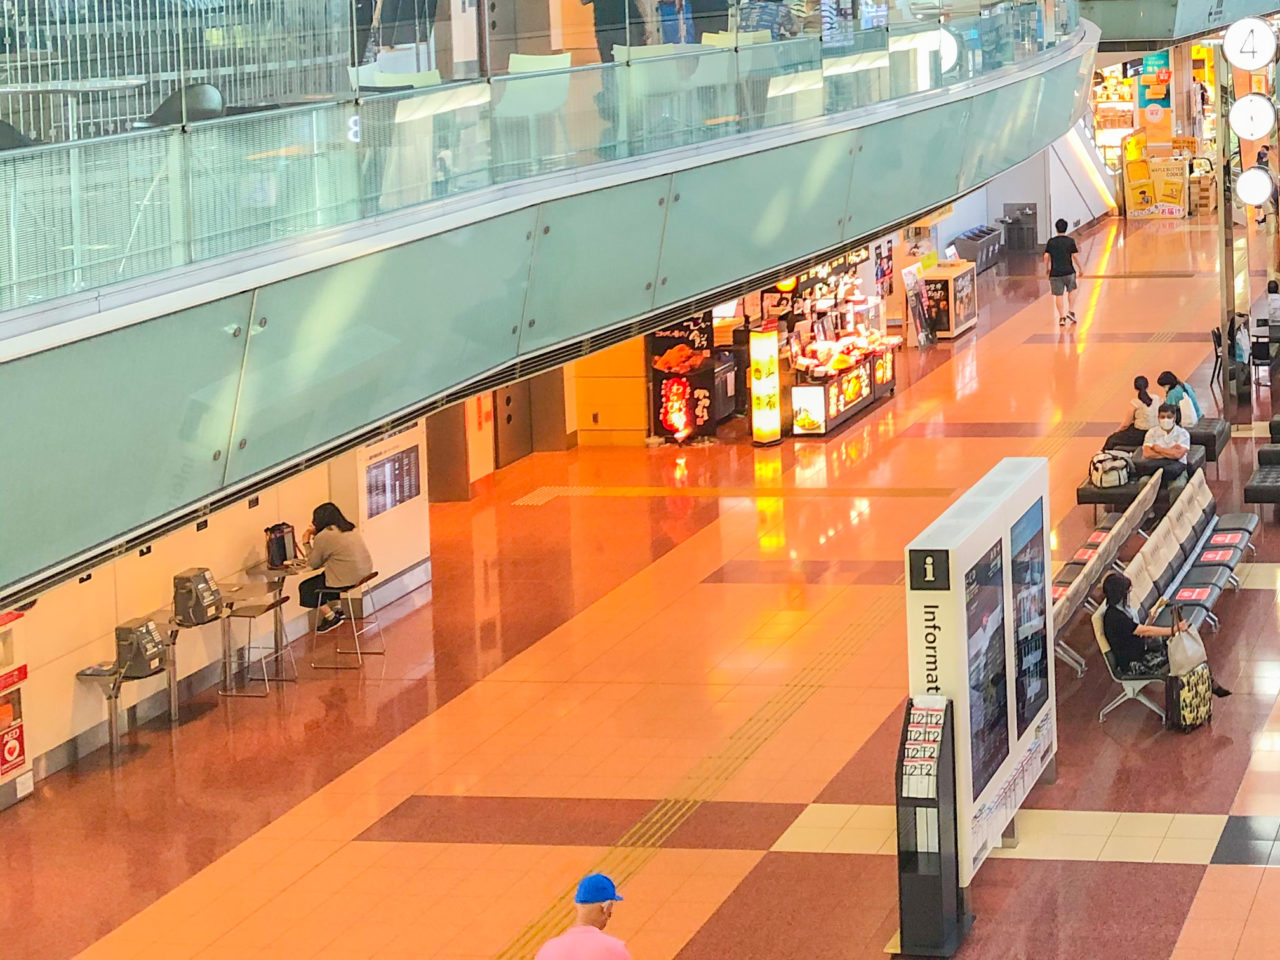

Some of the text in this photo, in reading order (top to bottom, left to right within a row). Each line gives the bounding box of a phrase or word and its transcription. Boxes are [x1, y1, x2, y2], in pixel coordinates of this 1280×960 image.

[1240, 29, 1257, 59] 4
[923, 605, 941, 693] Informat
[911, 713, 925, 725] T2
[928, 713, 942, 726] T2
[3, 729, 20, 740] AED
[908, 730, 922, 741] T2
[926, 731, 940, 742] T2
[905, 747, 919, 758] T2
[921, 746, 936, 758] T2
[903, 764, 917, 775] T2
[919, 763, 933, 776] T2
